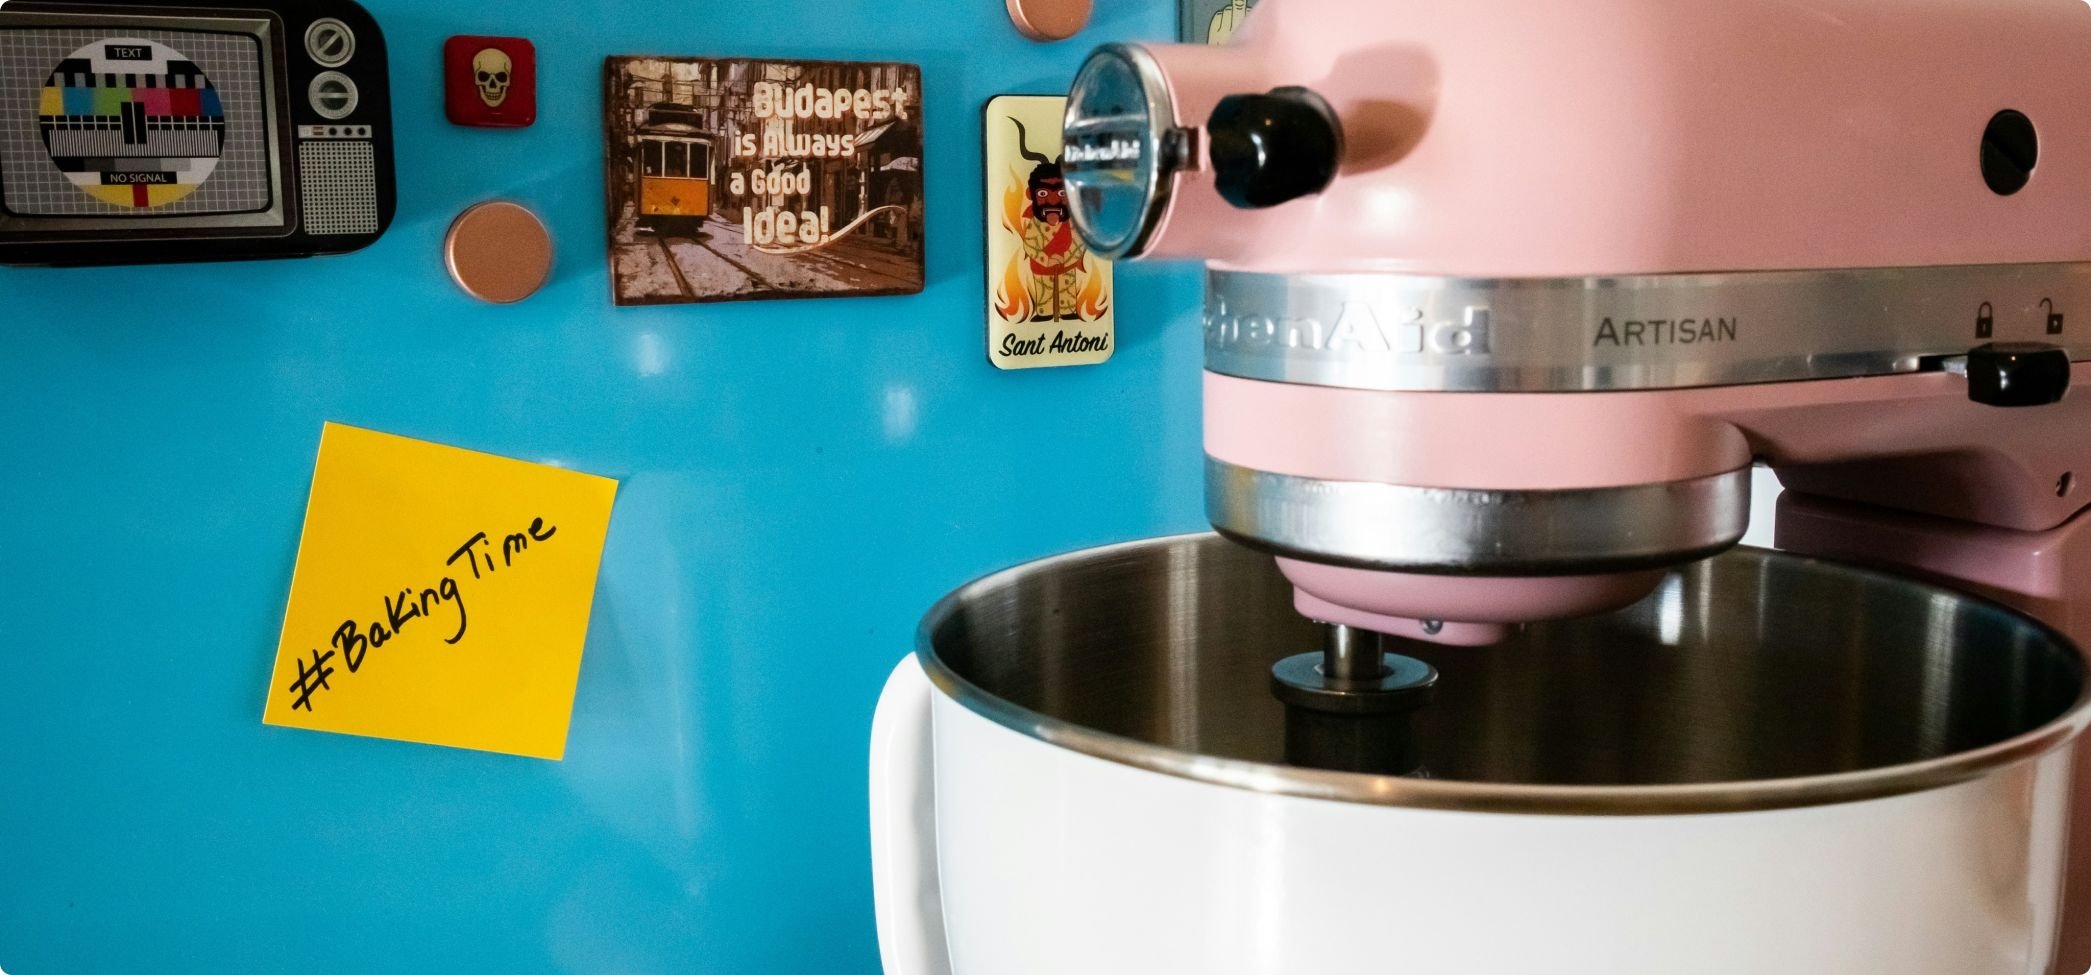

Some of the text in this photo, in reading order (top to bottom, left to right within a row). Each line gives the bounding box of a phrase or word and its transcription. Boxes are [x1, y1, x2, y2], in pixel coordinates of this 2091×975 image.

[114, 47, 143, 58] TEXT
[753, 81, 908, 119] Budapest
[735, 127, 855, 157] is Always
[109, 173, 168, 183] NO SIGNAL
[730, 168, 811, 195] a Good
[743, 205, 830, 245] Idea!
[998, 329, 1109, 357] Sant Antoni
[1593, 316, 1737, 347] ARTISAN
